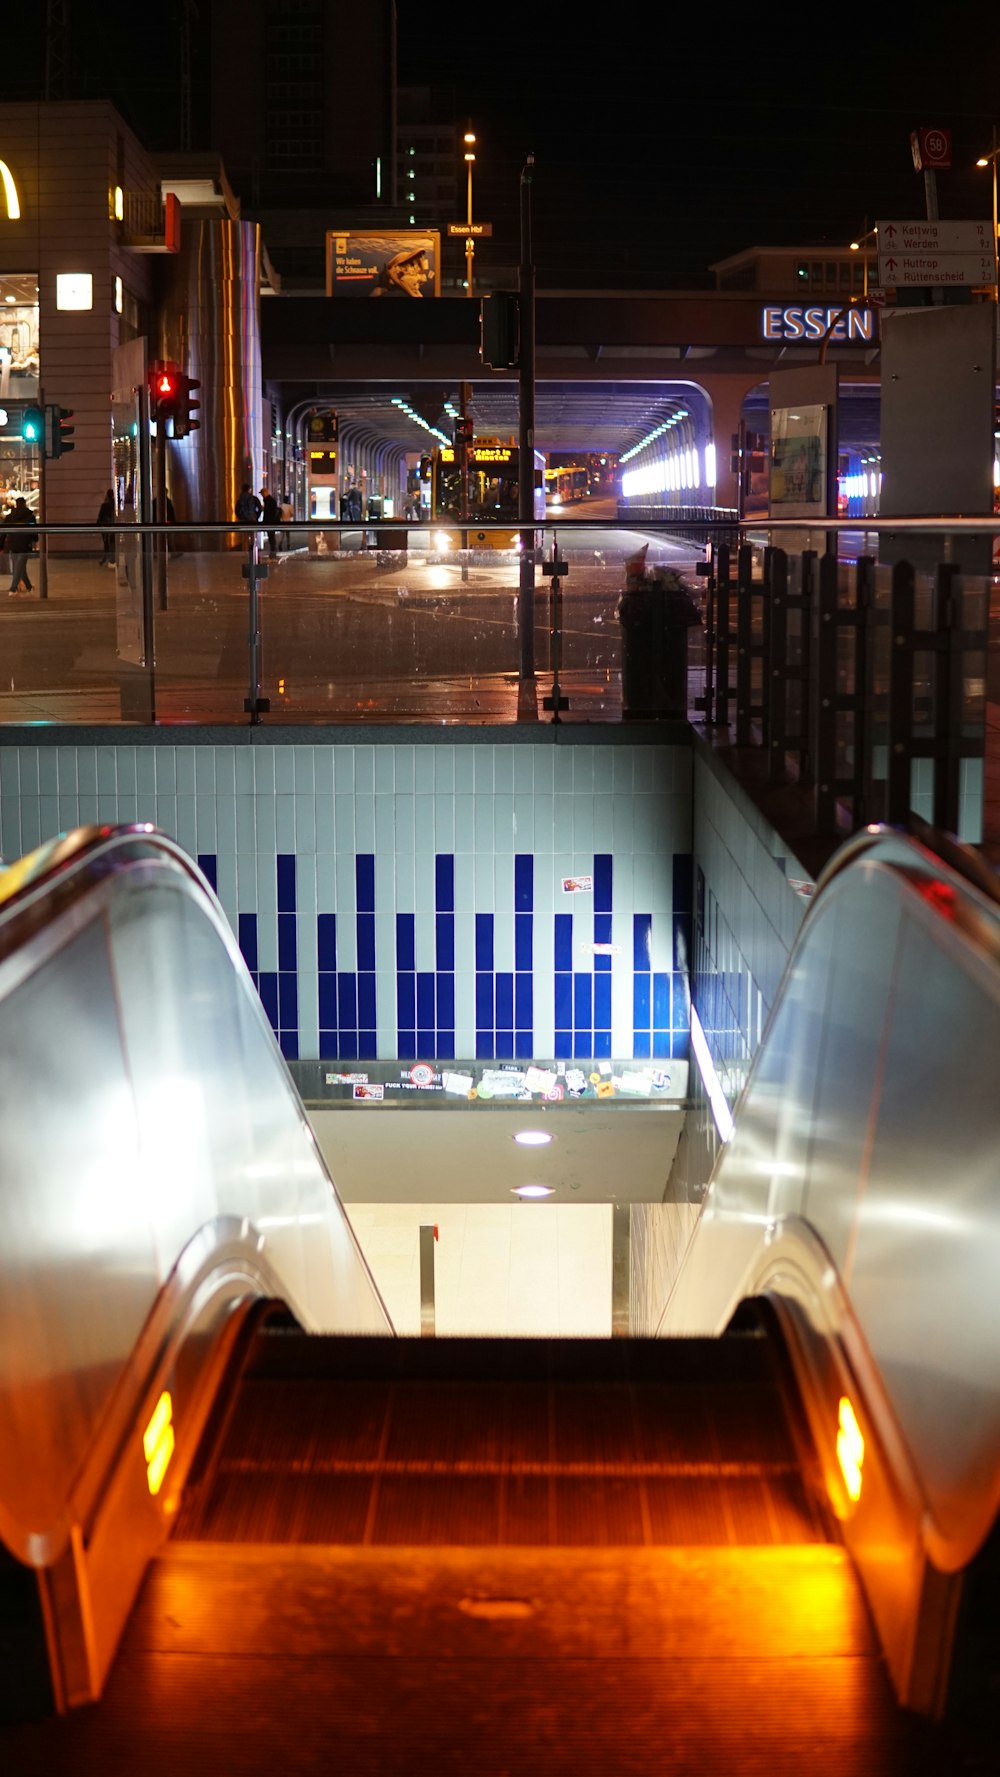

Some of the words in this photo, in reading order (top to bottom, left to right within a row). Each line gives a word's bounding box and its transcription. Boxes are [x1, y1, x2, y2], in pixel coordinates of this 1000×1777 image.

[929, 138, 942, 152] 58
[450, 225, 470, 233] Essen
[902, 225, 938, 237] Kettwig
[976, 225, 984, 235] 12
[903, 239, 939, 249] Werden
[903, 259, 938, 269] Huttrop
[904, 271, 964, 281] Rüttenscheid
[762, 307, 873, 340] ESSEN
